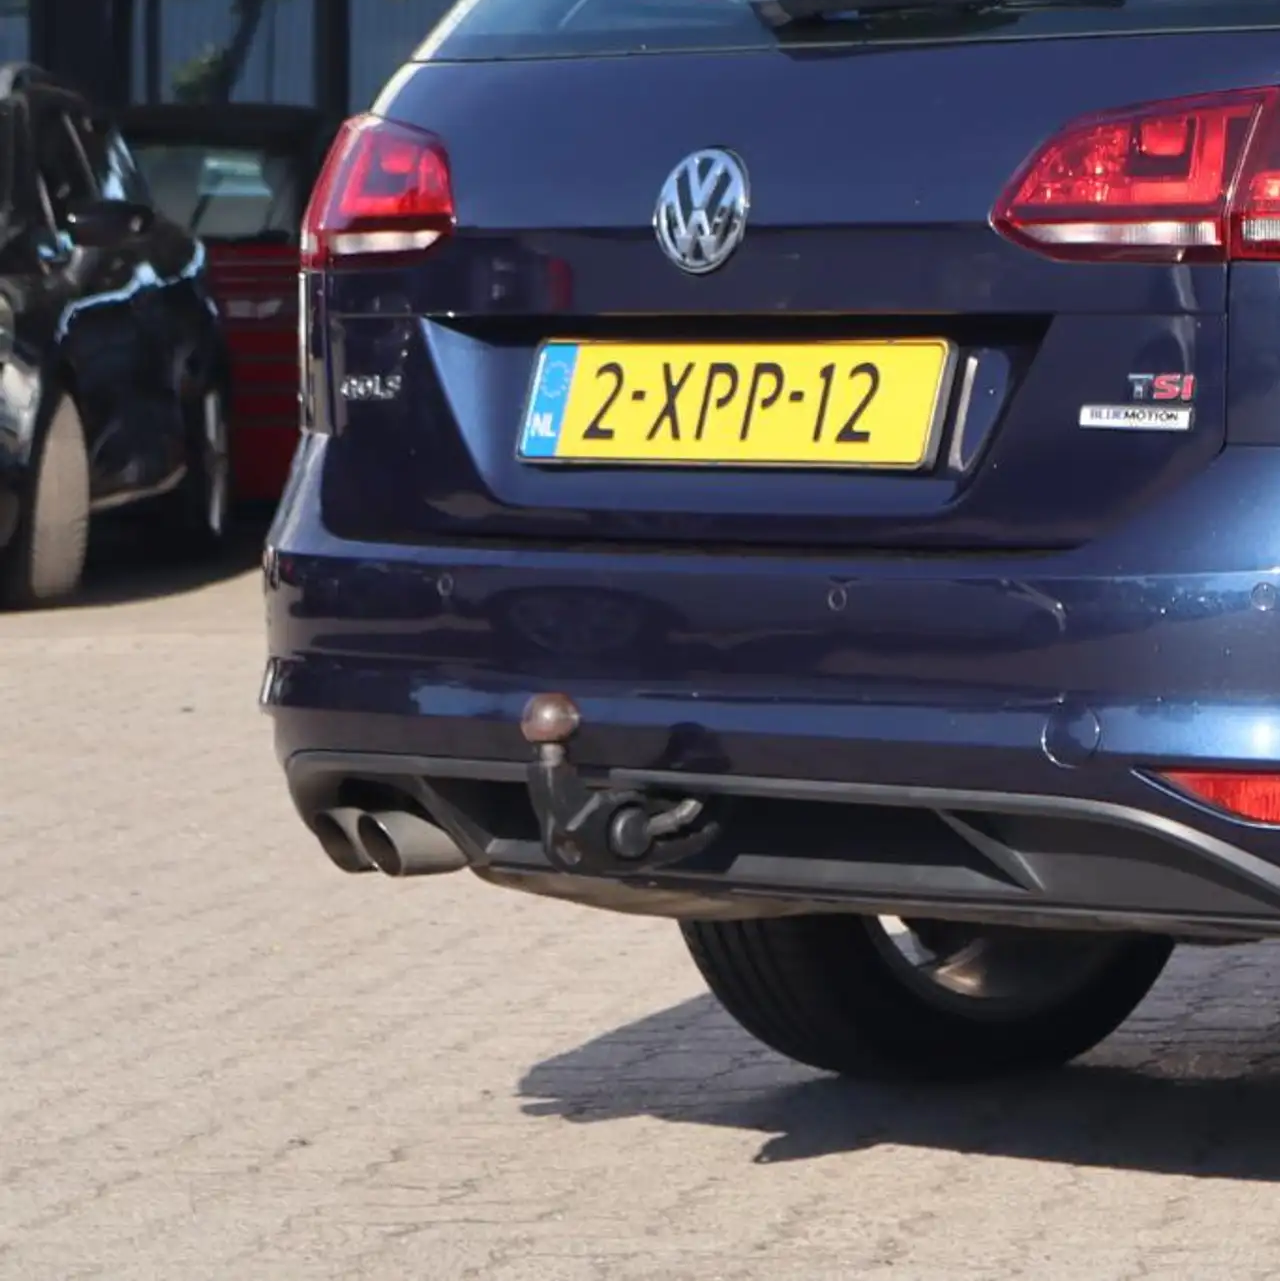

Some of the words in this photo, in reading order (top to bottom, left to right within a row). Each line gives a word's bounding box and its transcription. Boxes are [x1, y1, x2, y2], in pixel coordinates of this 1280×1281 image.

[530, 411, 556, 437] NL
[582, 361, 881, 444] 2-XPP-12
[1128, 372, 1197, 400] TSI
